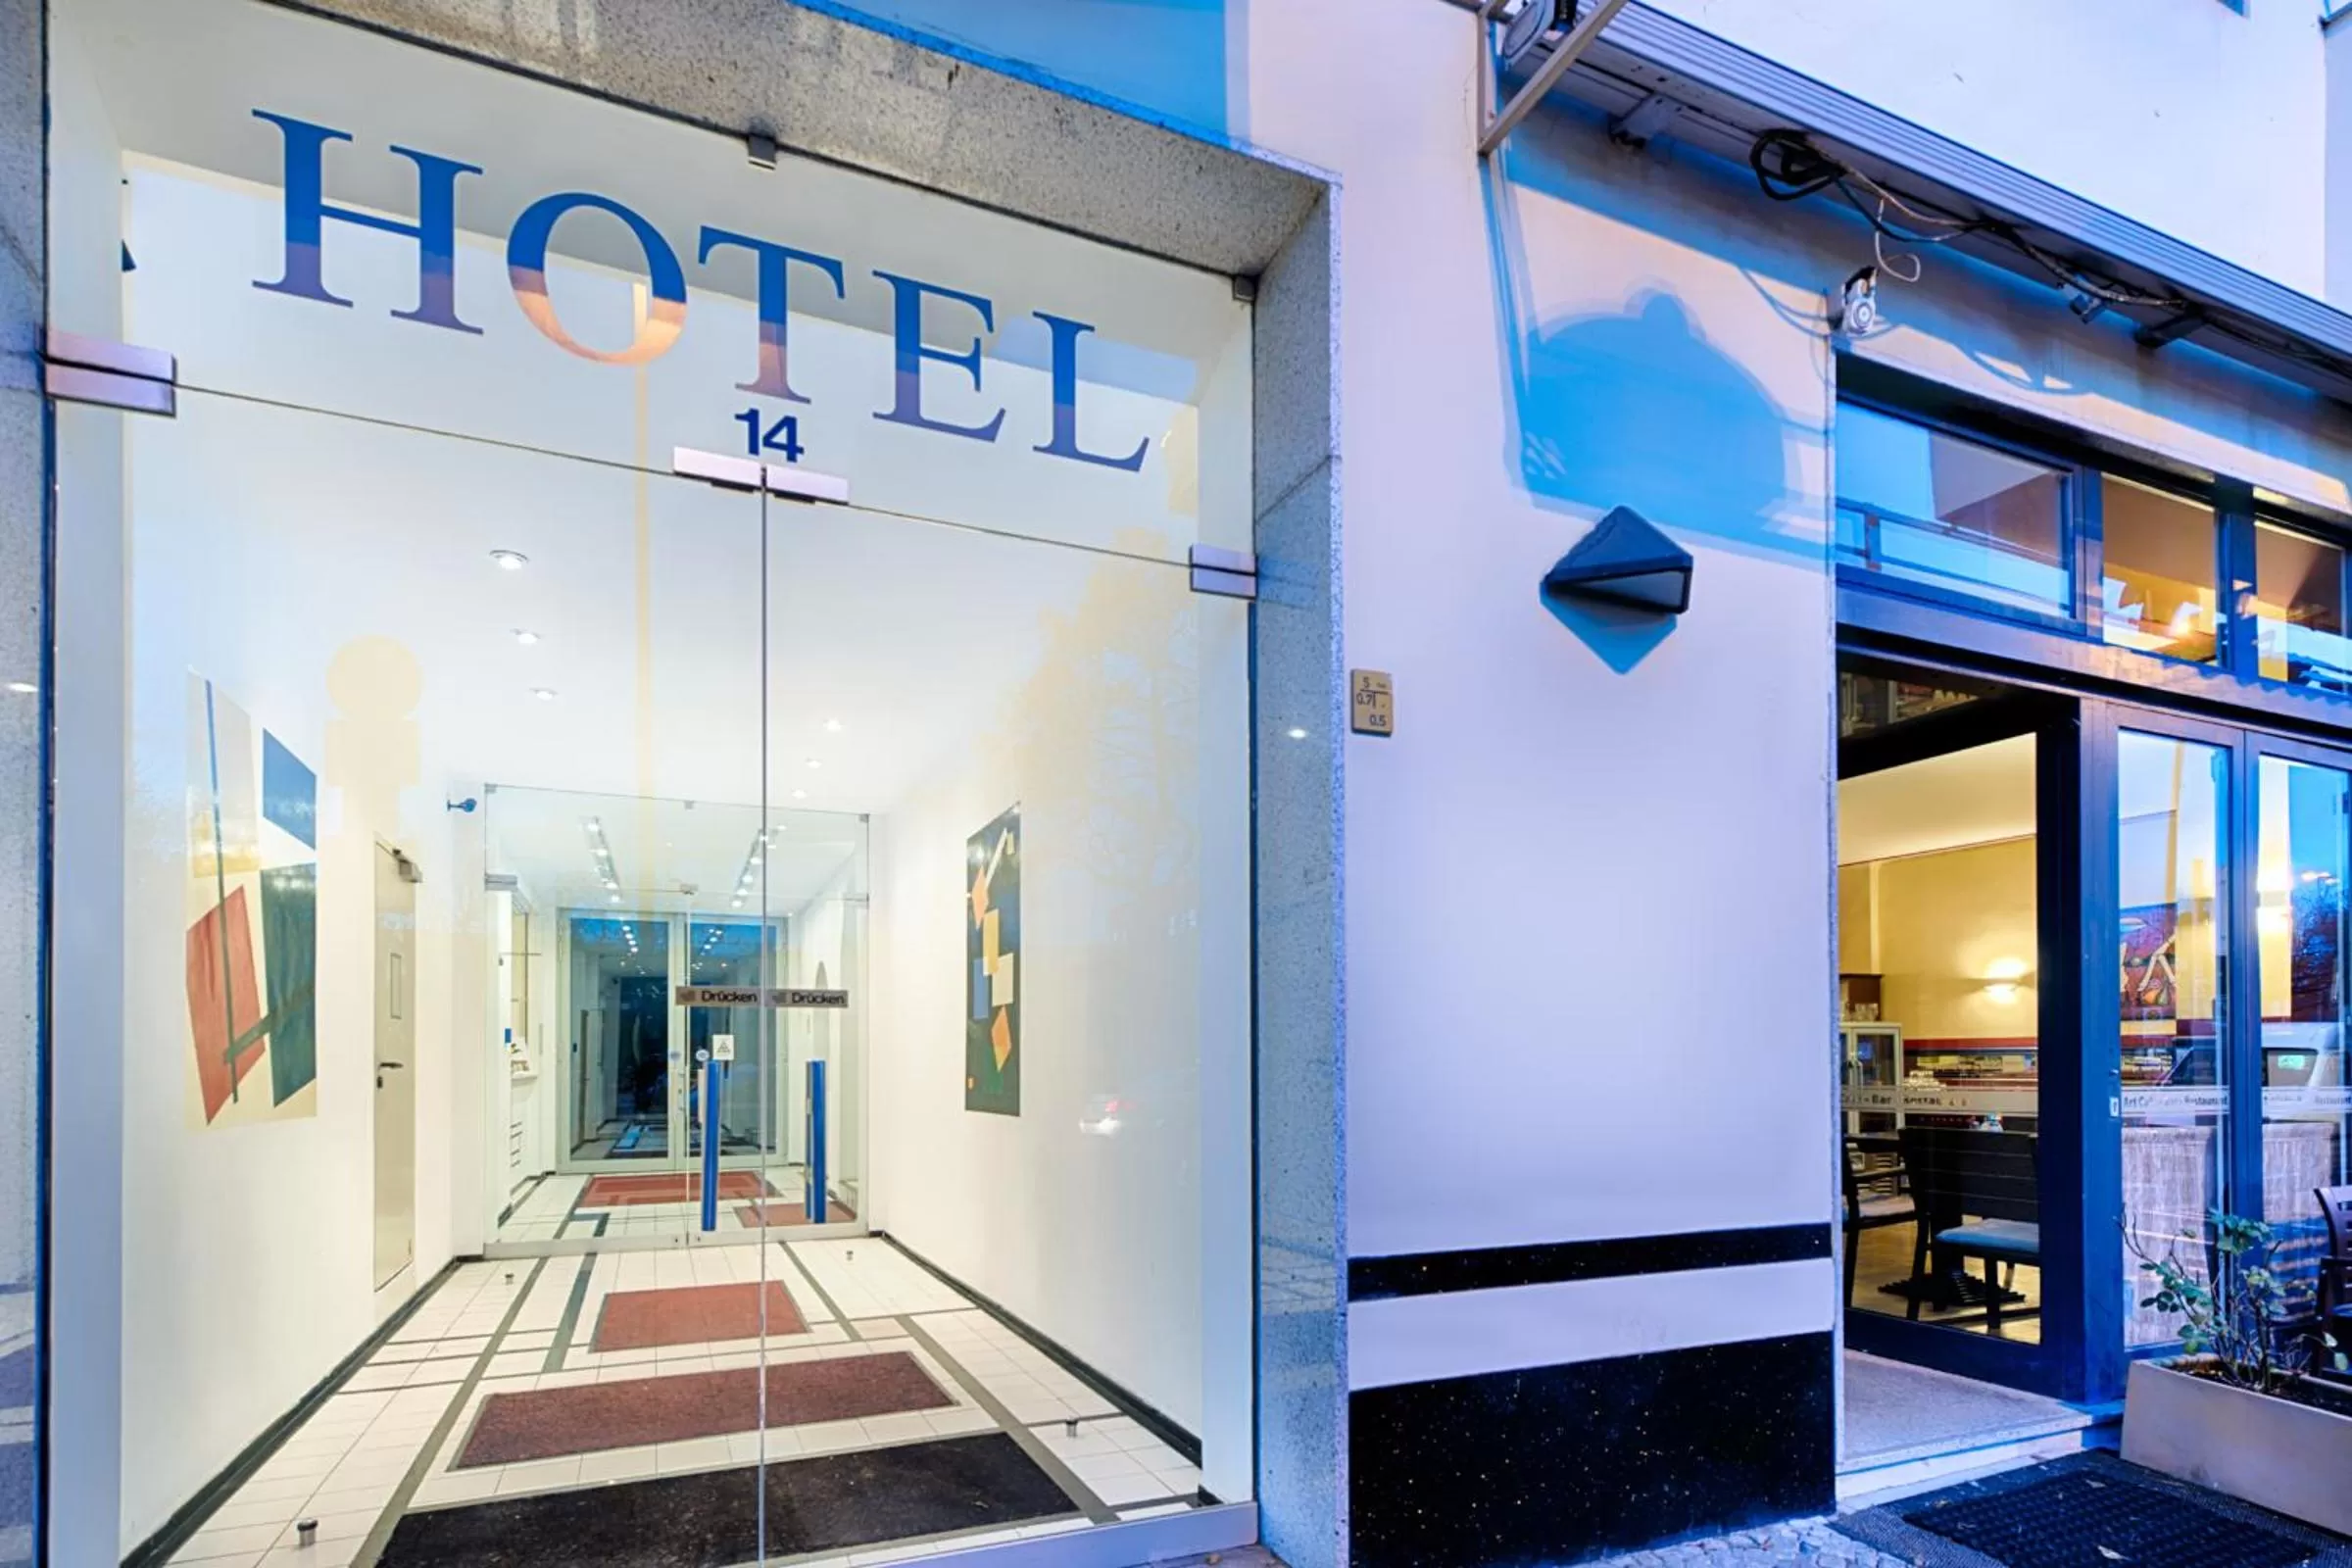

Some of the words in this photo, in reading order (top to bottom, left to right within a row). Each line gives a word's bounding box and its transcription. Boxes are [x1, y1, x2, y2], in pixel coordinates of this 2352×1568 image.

[251, 109, 1151, 472] HOTEL
[734, 409, 805, 463] 14
[701, 991, 758, 1003] Drücken
[792, 992, 845, 1004] Drücken
